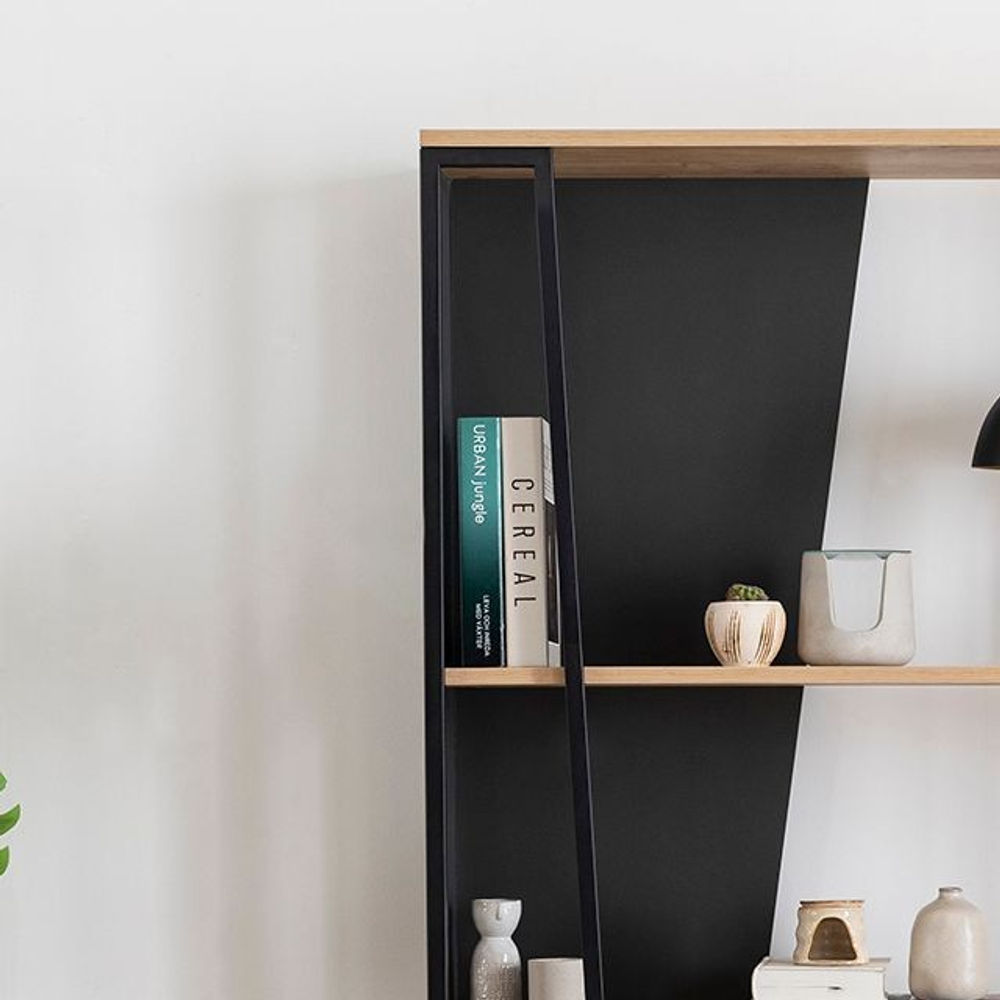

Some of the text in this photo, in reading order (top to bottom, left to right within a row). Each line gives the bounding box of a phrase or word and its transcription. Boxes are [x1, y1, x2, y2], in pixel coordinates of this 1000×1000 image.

[470, 424, 487, 524] URBAN jungle
[511, 478, 536, 608] CEREAL
